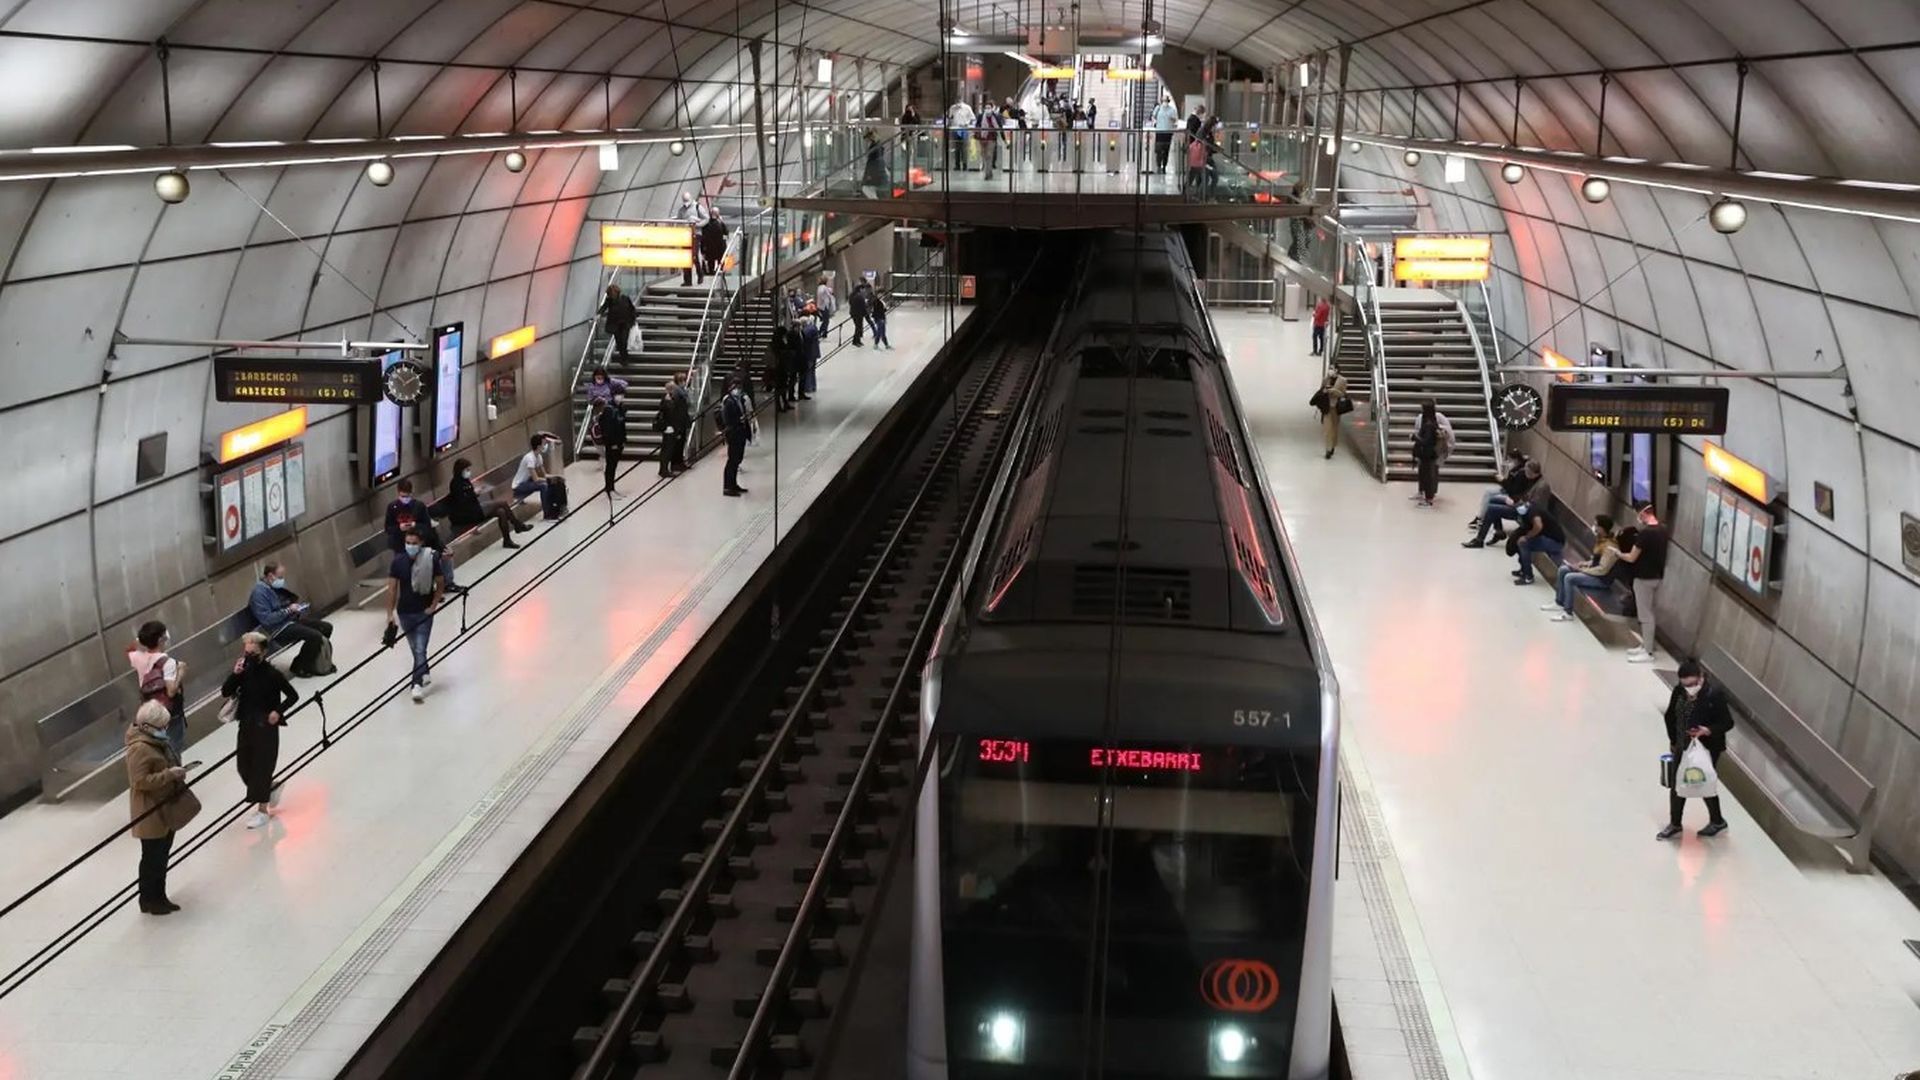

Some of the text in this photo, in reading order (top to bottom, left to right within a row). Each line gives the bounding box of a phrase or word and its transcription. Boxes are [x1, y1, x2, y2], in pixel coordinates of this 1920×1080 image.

[235, 386, 286, 396] KABIEZES
[1233, 709, 1292, 729] 557-1
[980, 739, 1202, 771] 3534 ETXEBARRI
